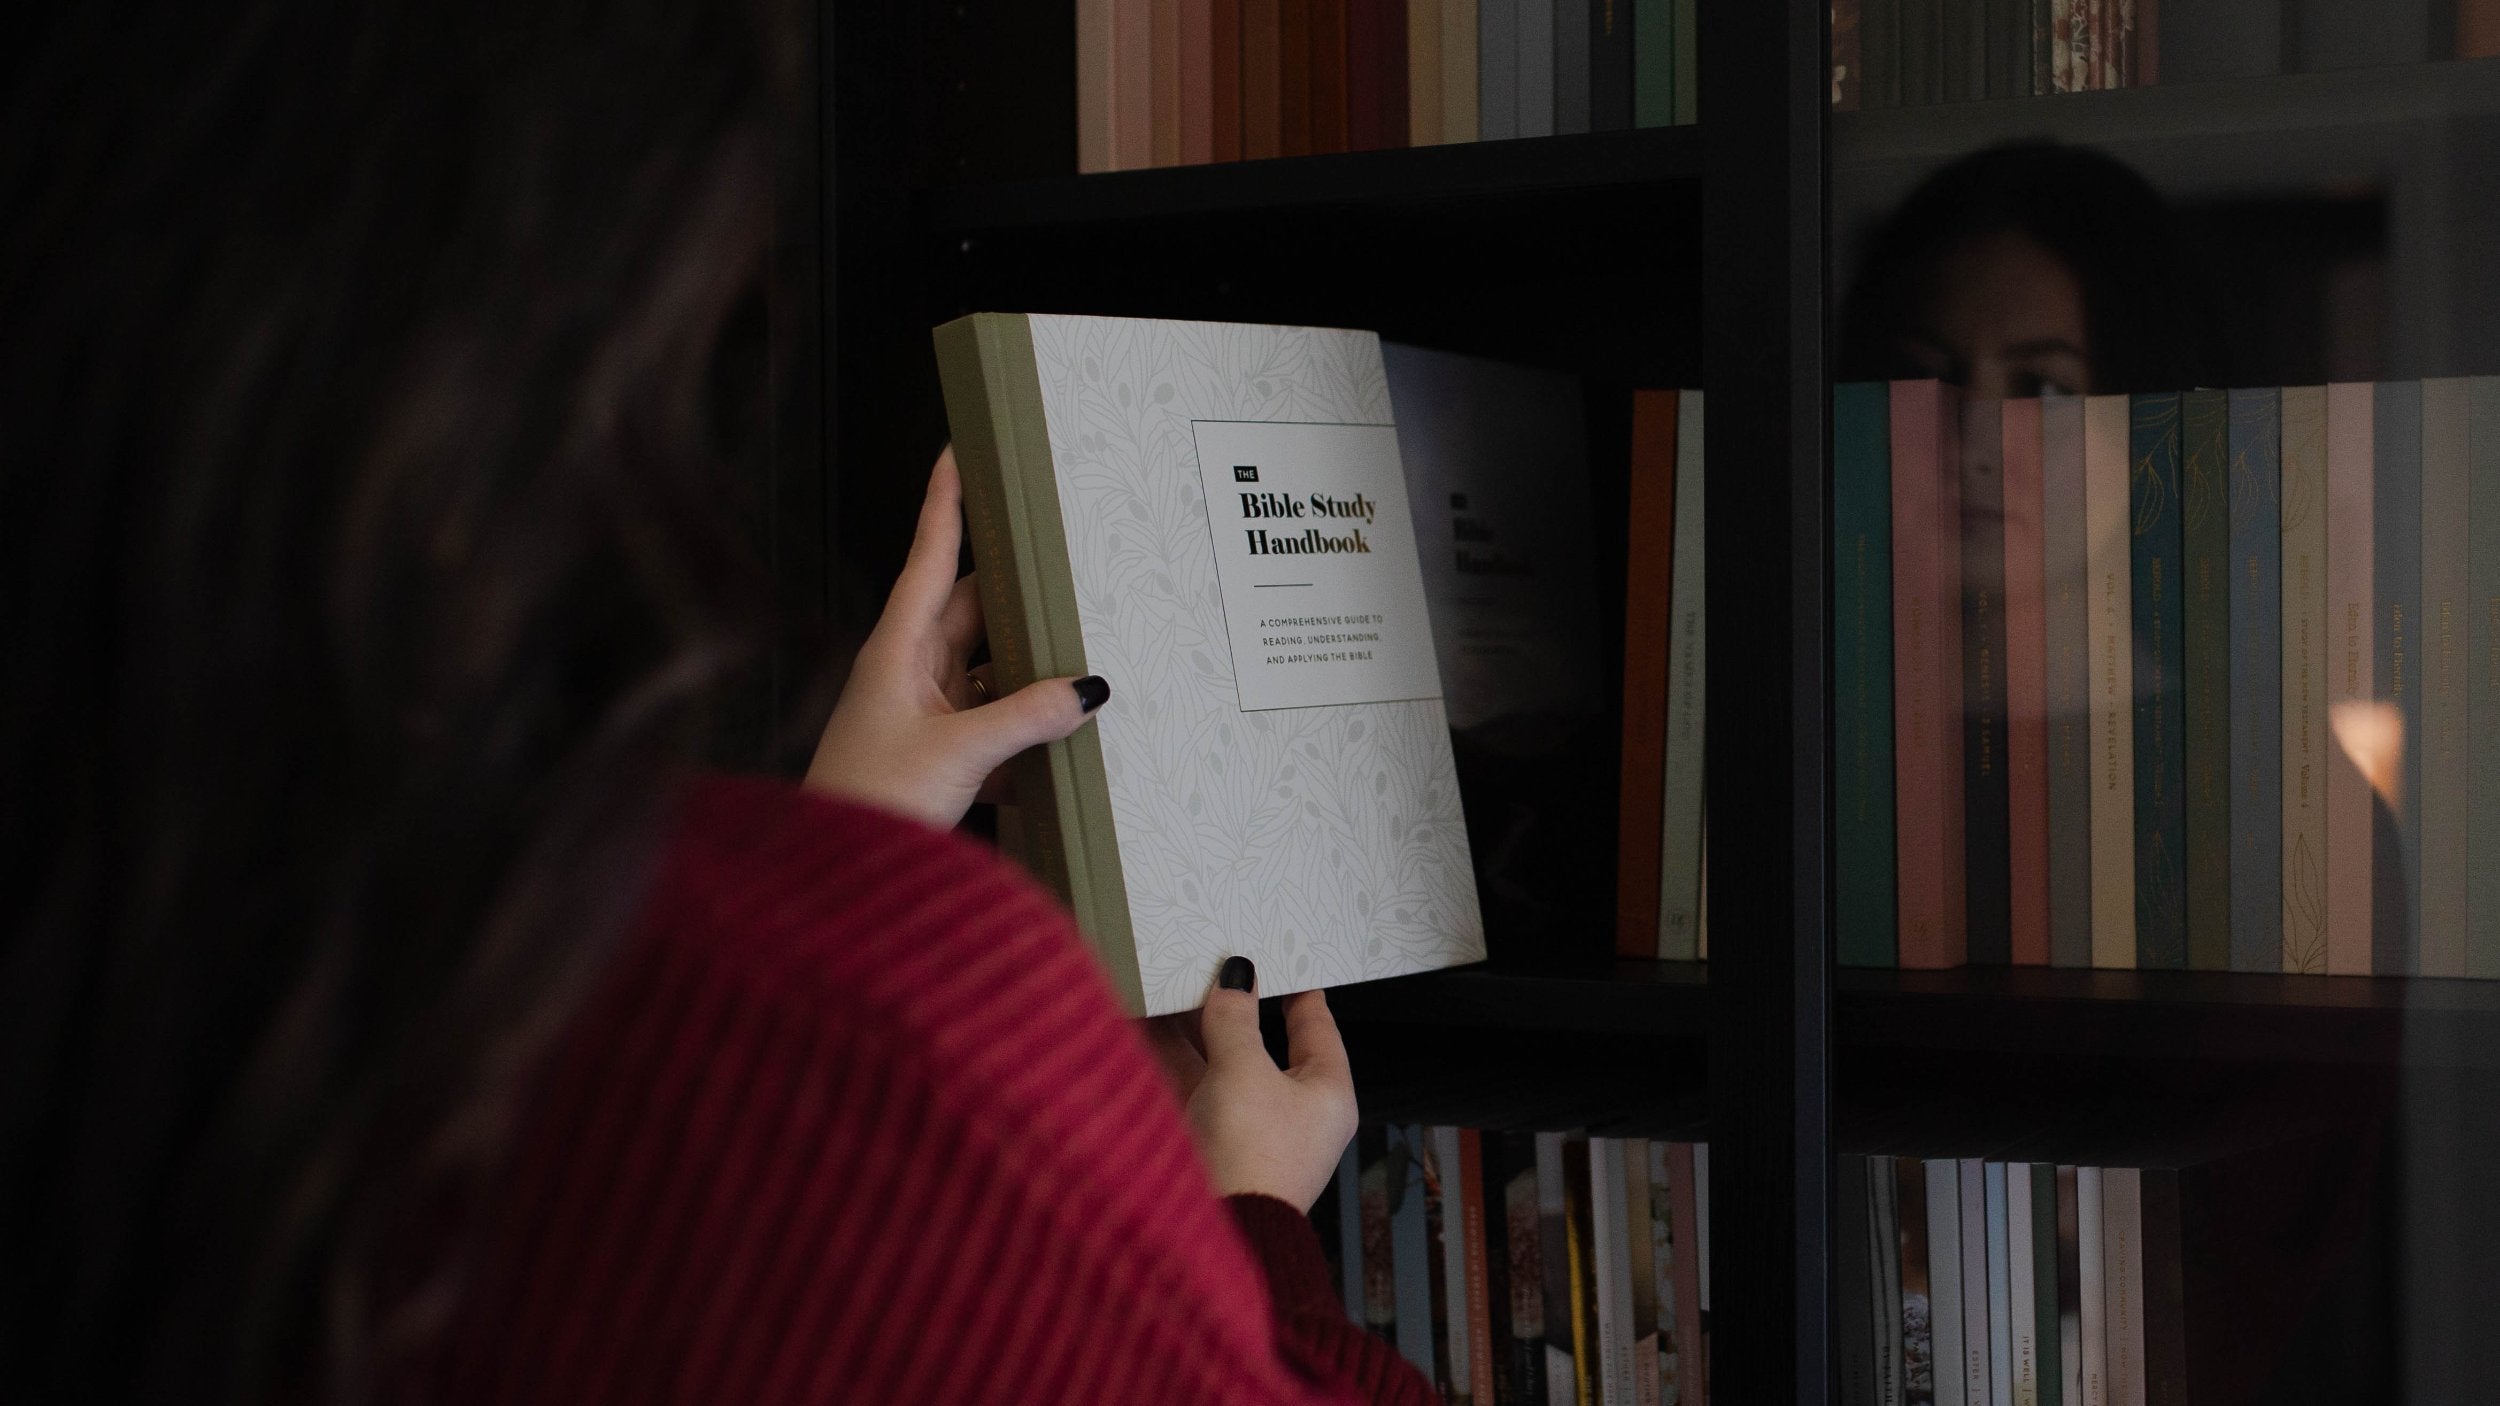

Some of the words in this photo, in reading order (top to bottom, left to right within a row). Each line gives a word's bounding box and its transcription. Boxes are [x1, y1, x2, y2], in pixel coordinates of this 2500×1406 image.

[1236, 469, 1257, 480] THE
[1238, 493, 1305, 518] Bible
[1310, 493, 1376, 524] Study
[1245, 529, 1371, 555] Handbook
[1260, 619, 1266, 628] A
[1268, 616, 1342, 628] COMPREHENSIVE
[1344, 615, 1369, 625] GUIDE
[1372, 614, 1383, 624] TO
[2348, 636, 2359, 647] to
[1267, 655, 1285, 664] AND
[1288, 653, 1328, 663] APPLYING
[1331, 652, 1346, 661] THE
[1349, 650, 1373, 660] BIBLE
[2108, 712, 2117, 790] REVELATION
[2022, 1336, 2030, 1344] IT
[2022, 1347, 2030, 1355] IS
[2022, 1358, 2030, 1383] WELL
